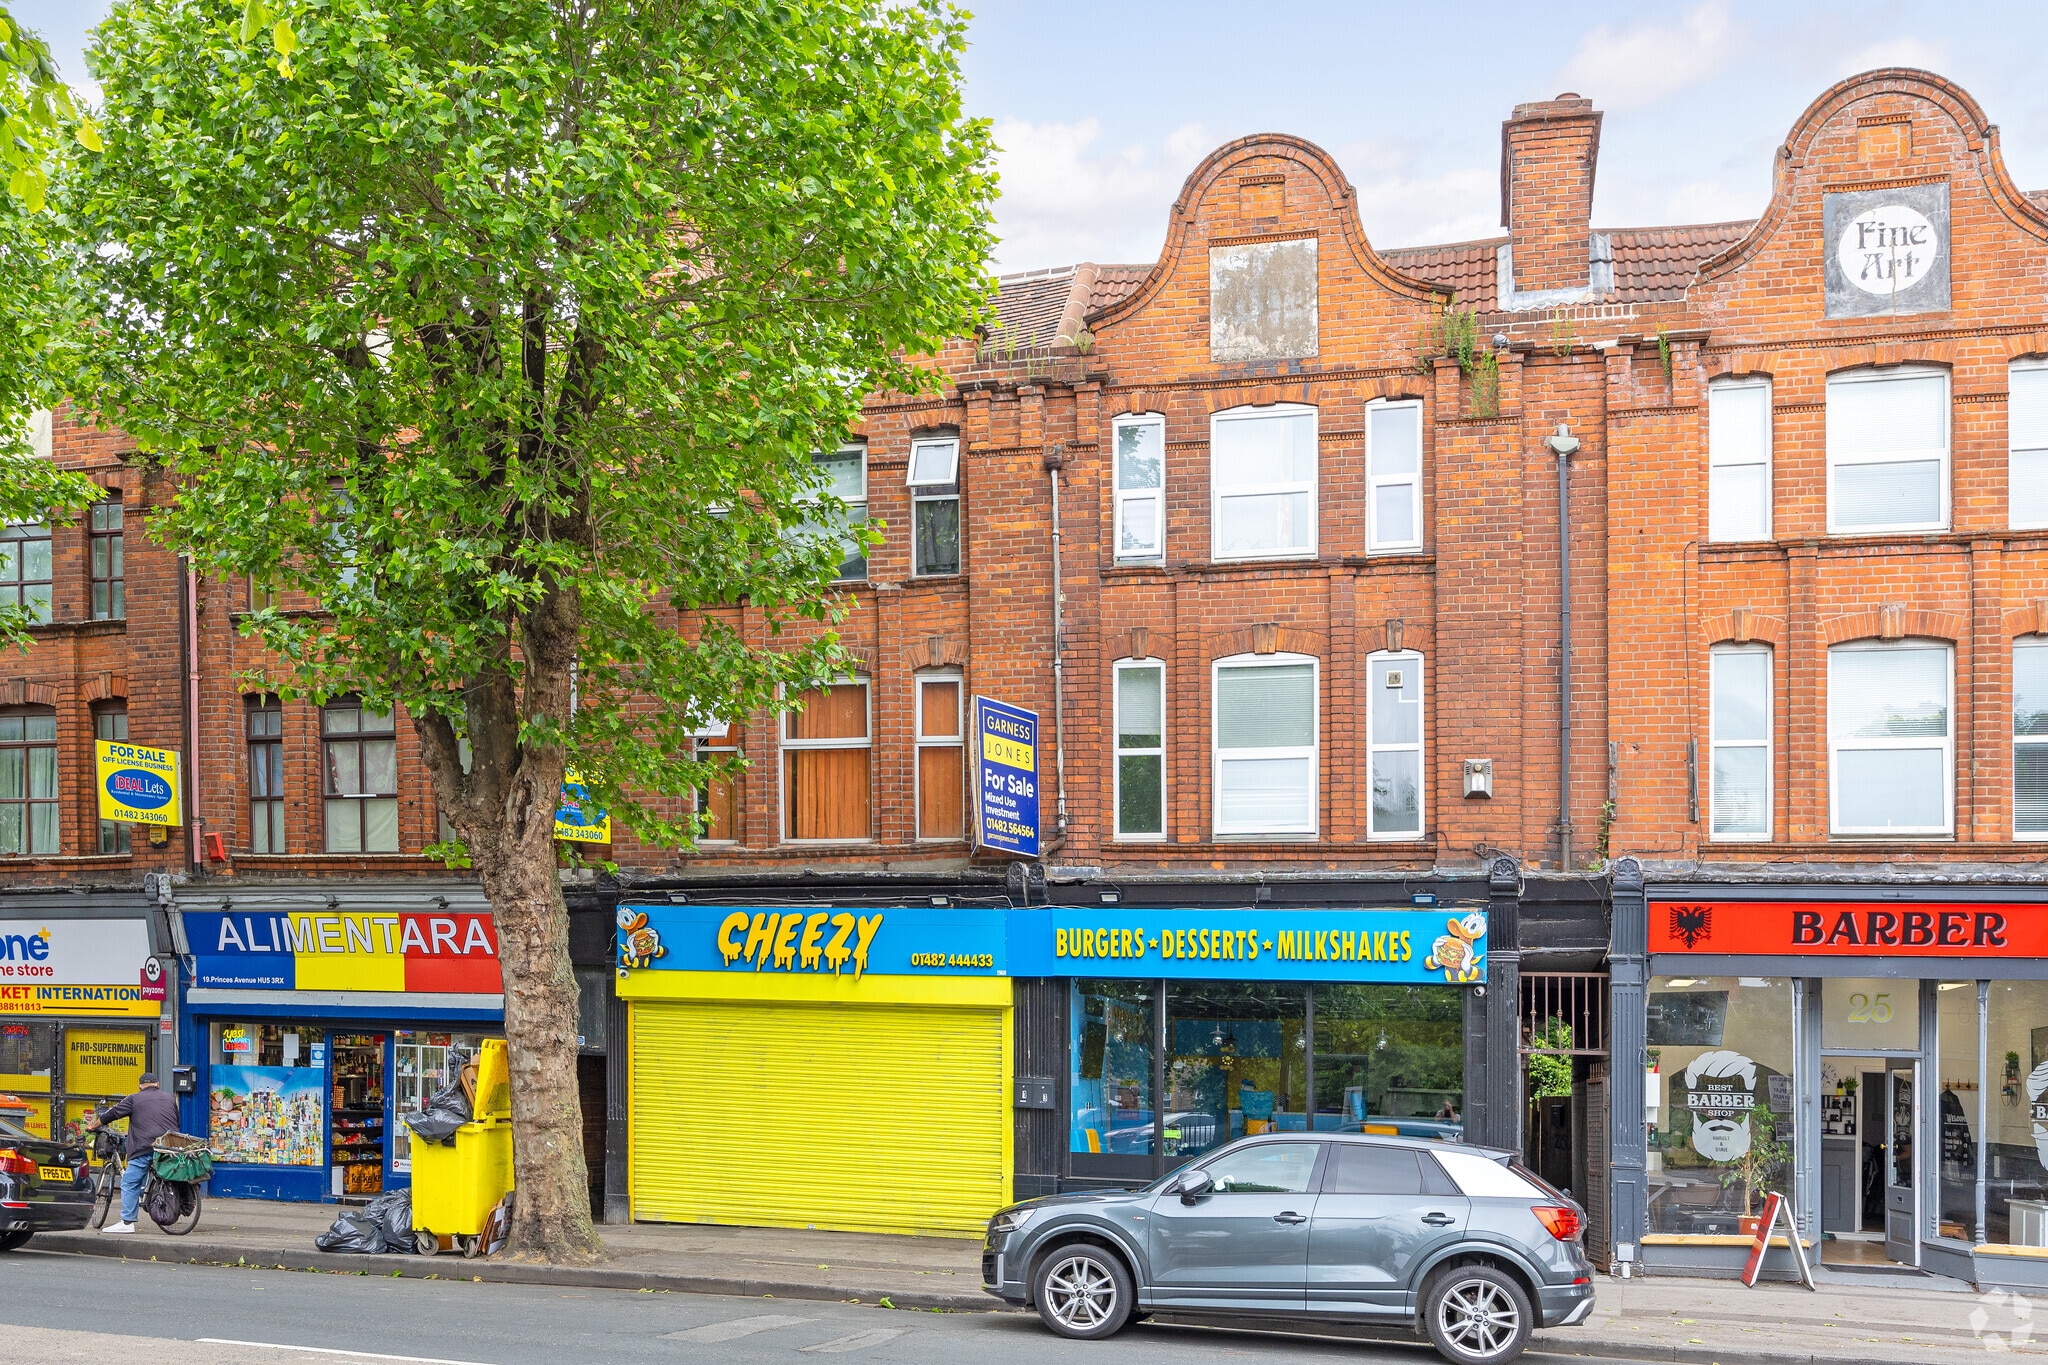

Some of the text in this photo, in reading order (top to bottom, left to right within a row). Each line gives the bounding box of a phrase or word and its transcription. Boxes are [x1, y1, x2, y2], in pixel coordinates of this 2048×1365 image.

[1856, 221, 1927, 250] Fine
[1861, 251, 1920, 281] Art
[987, 715, 1030, 740] GARNESS
[110, 745, 166, 762] FOR SALE
[988, 741, 1030, 764] JONES
[117, 758, 143, 767] LICENSE
[145, 762, 173, 771] BUSINESS
[145, 780, 164, 794] Lets
[985, 768, 1034, 798] For Sale
[985, 791, 1017, 808] Mixed Use
[114, 809, 168, 822] 01482 343060
[985, 804, 1020, 820] Investment
[576, 829, 603, 840] 343060
[986, 817, 1034, 838] 01482 564564
[217, 916, 494, 954] ALIMENTARA
[1791, 911, 2008, 947] BARBER
[717, 911, 884, 980] CHEEZY
[1056, 928, 1412, 961] BURGERS DESSERTS MILKSHAKES
[911, 953, 993, 967] 01482 444433
[17, 964, 53, 976] store
[0, 987, 140, 1001] KET INTERNATION
[142, 987, 164, 995] payzone
[1848, 993, 1894, 1023] 25
[80, 1055, 138, 1067] INTERNATIONAL
[1687, 1094, 1755, 1107] BARBER
[2036, 1106, 2048, 1119] B
